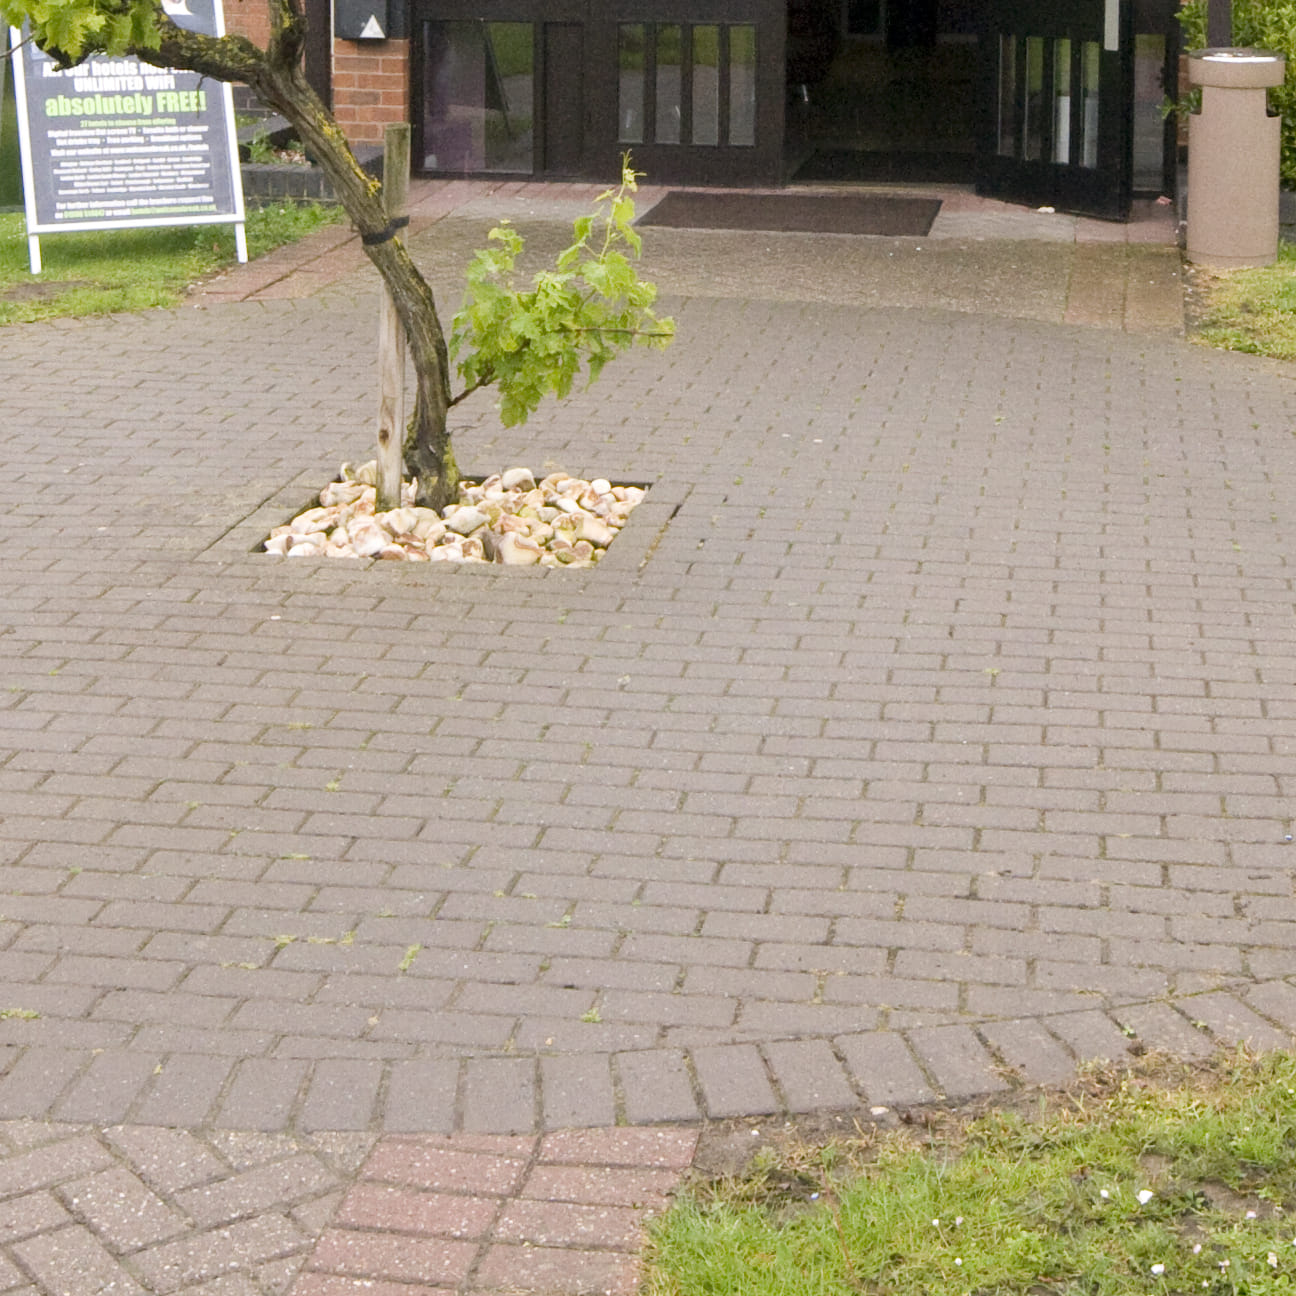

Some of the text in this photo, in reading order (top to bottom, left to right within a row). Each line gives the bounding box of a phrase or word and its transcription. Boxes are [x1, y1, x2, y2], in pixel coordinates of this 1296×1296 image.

[91, 60, 138, 76] hotels
[74, 76, 144, 92] UNLIMITED
[45, 91, 207, 117] absolutely FREE!
